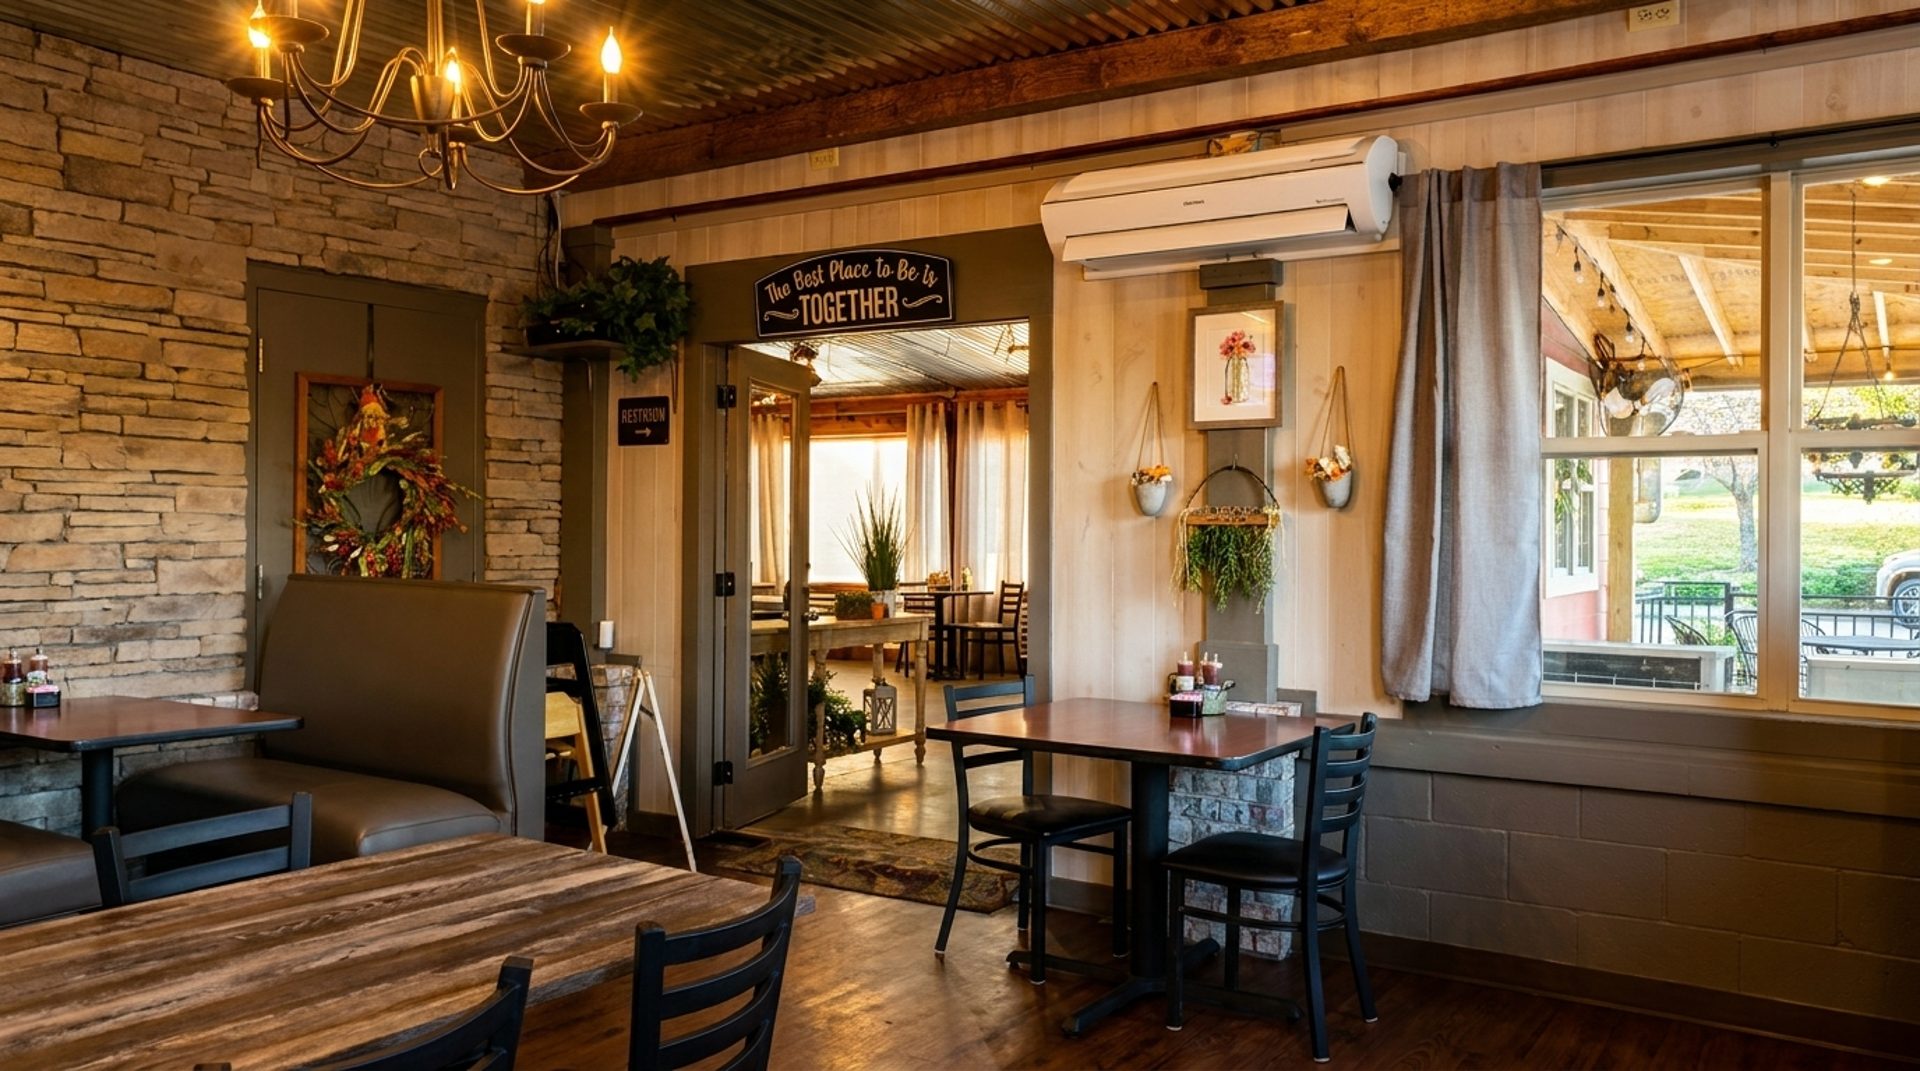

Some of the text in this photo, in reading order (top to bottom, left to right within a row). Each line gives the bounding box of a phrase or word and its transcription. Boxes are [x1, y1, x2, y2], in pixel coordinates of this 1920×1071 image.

[764, 281, 791, 304] The
[793, 264, 825, 291] Best
[829, 258, 872, 282] Place
[876, 256, 894, 278] to
[897, 258, 920, 281] Be
[798, 286, 900, 326] TOGETHER
